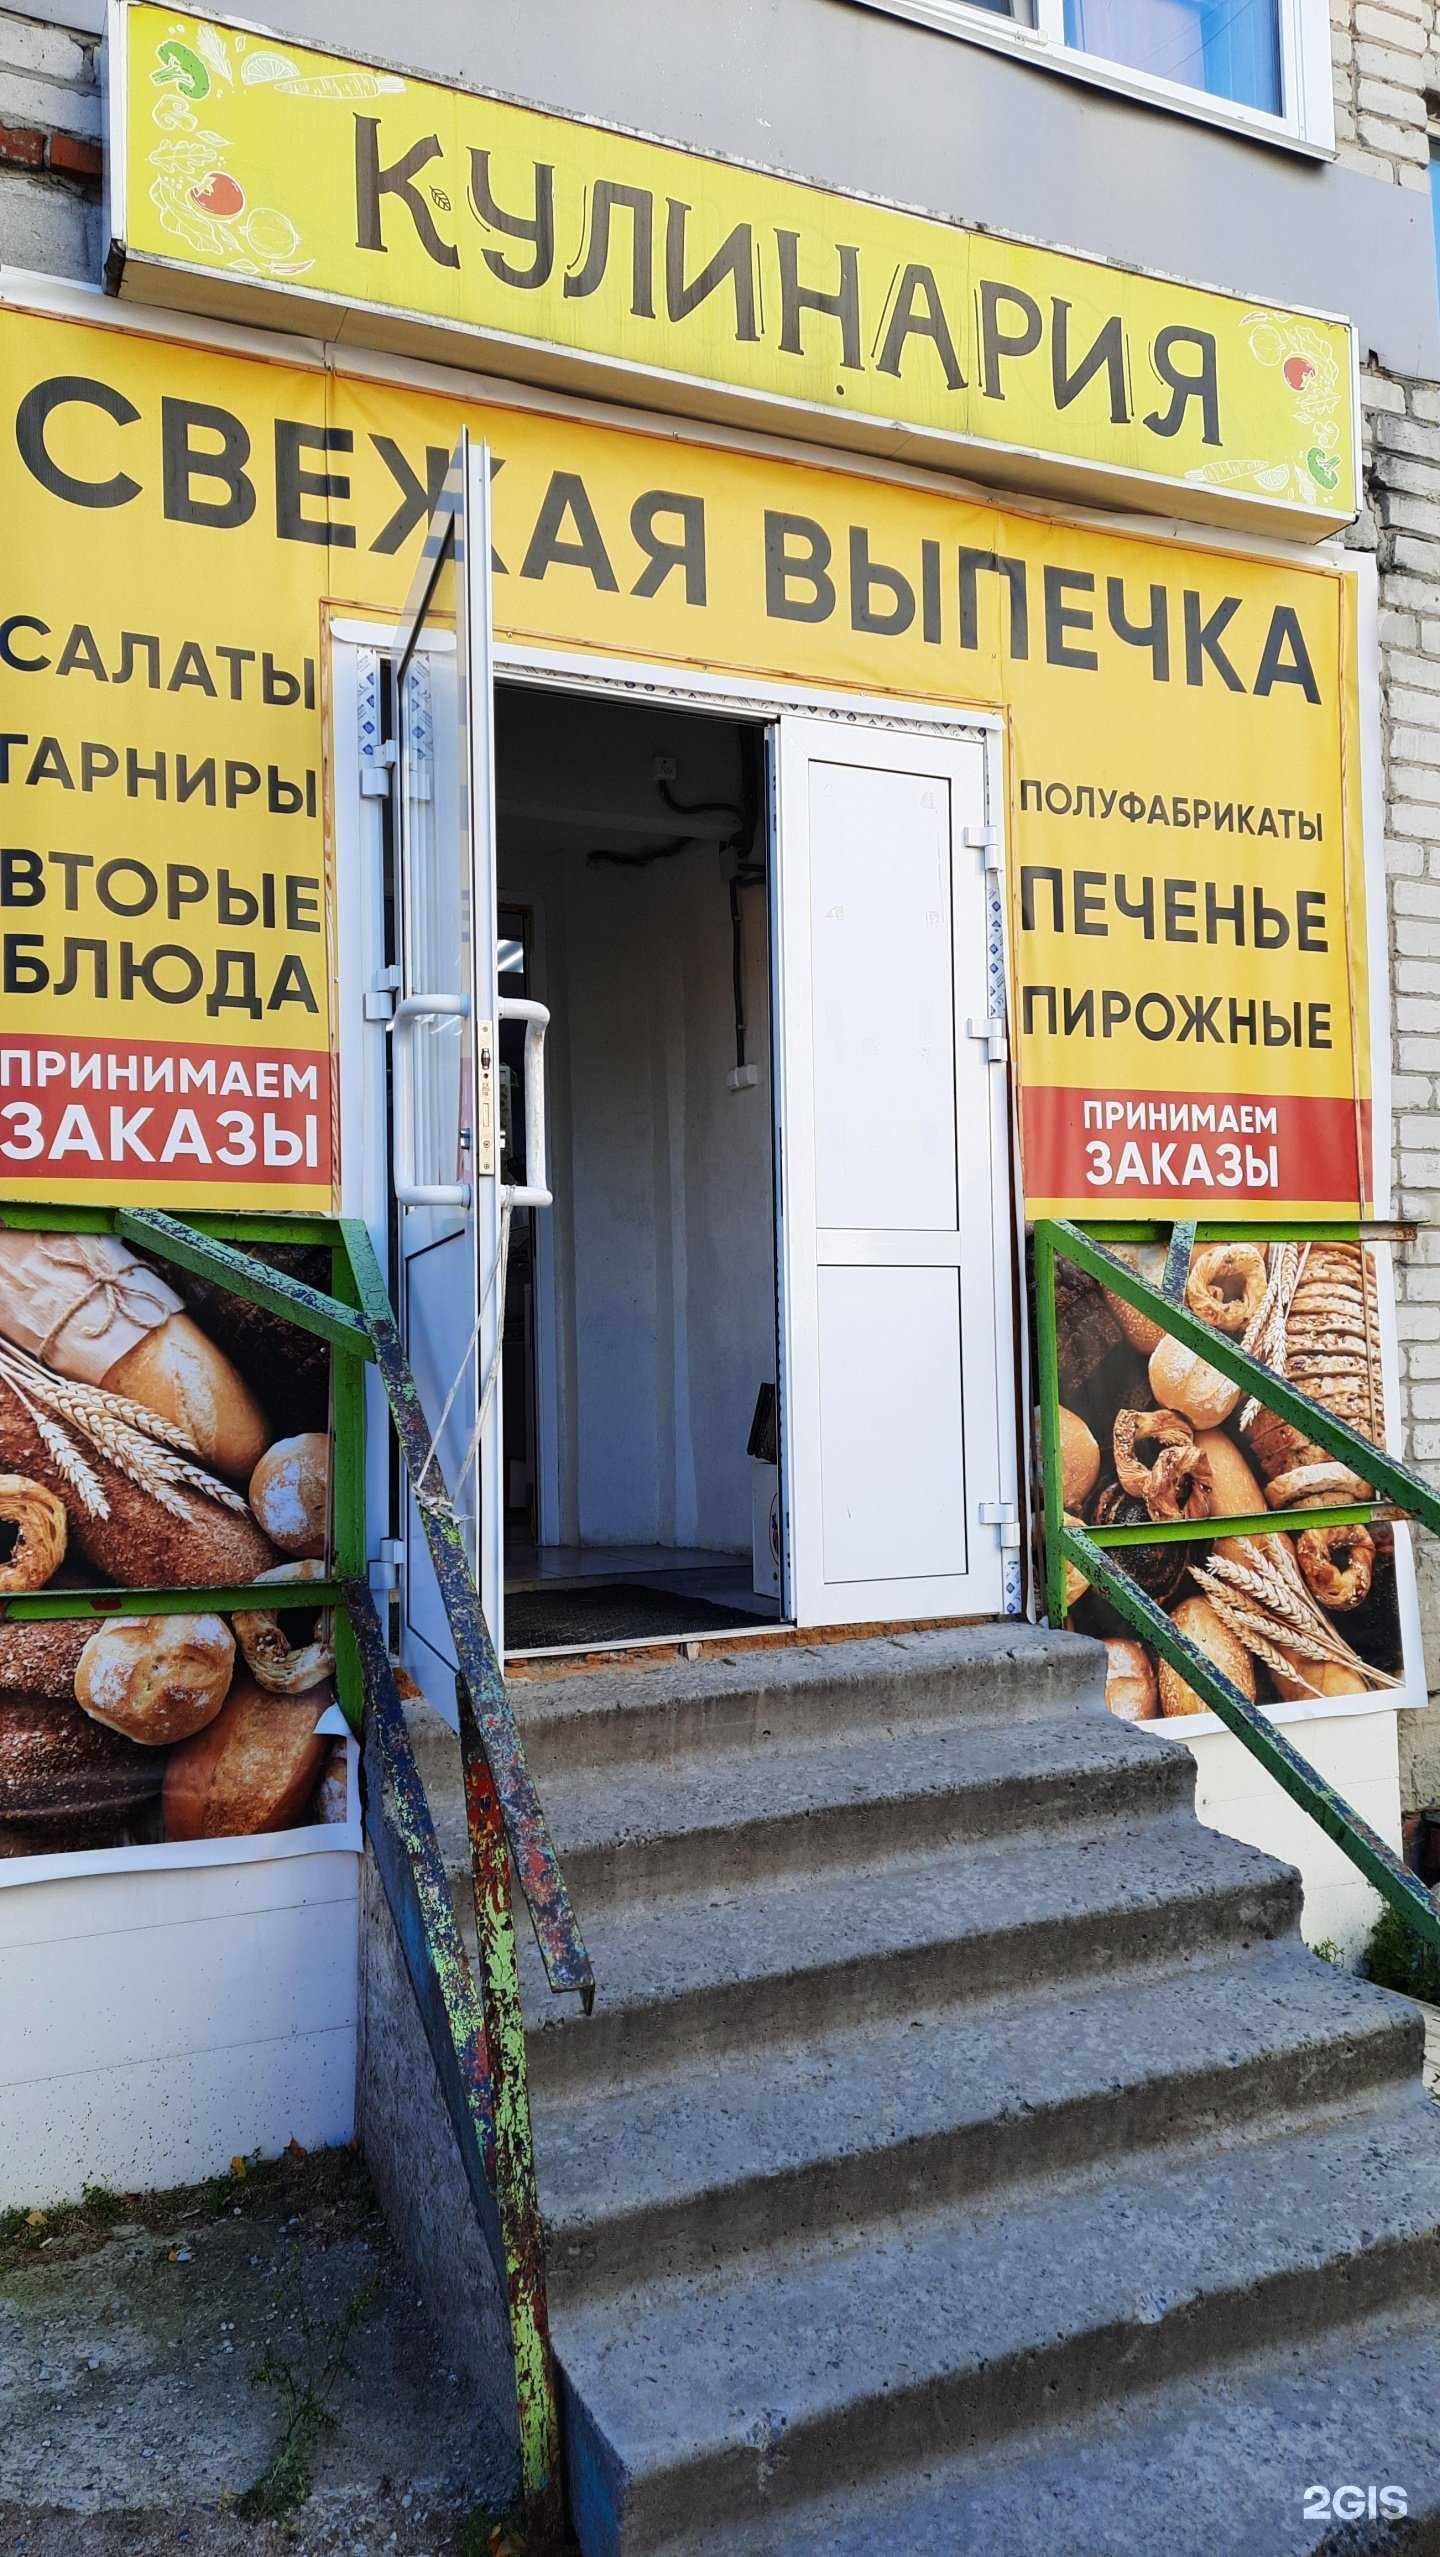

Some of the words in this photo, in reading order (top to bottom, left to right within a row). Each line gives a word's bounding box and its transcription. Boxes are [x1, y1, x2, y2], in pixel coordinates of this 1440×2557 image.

[353, 112, 1223, 448] КУЛИНАРИЯ
[15, 375, 708, 608] СВЕЖАЯ
[763, 508, 1322, 705] ВЫПЕЧКА
[0, 614, 316, 710] САЛАТЫ
[0, 733, 318, 818] ГАРНИРЫ
[1020, 779, 1324, 843] ПОЛУФАБРИКАТЫ
[0, 848, 322, 934] ВТОРЫЕ
[1020, 865, 1329, 953] ПЕЧЕНЬЕ
[3, 933, 321, 1021] БЛЮДА
[1022, 985, 1334, 1050] ПИРОЖНЫЕ
[0, 1049, 319, 1100] ПРИНИМАЕМ
[0, 1101, 319, 1169] ЗАКАЗЫ
[1083, 1100, 1278, 1135] ПРИНИМАЕМ
[1085, 1141, 1280, 1188] ЗАКАЗЫ
